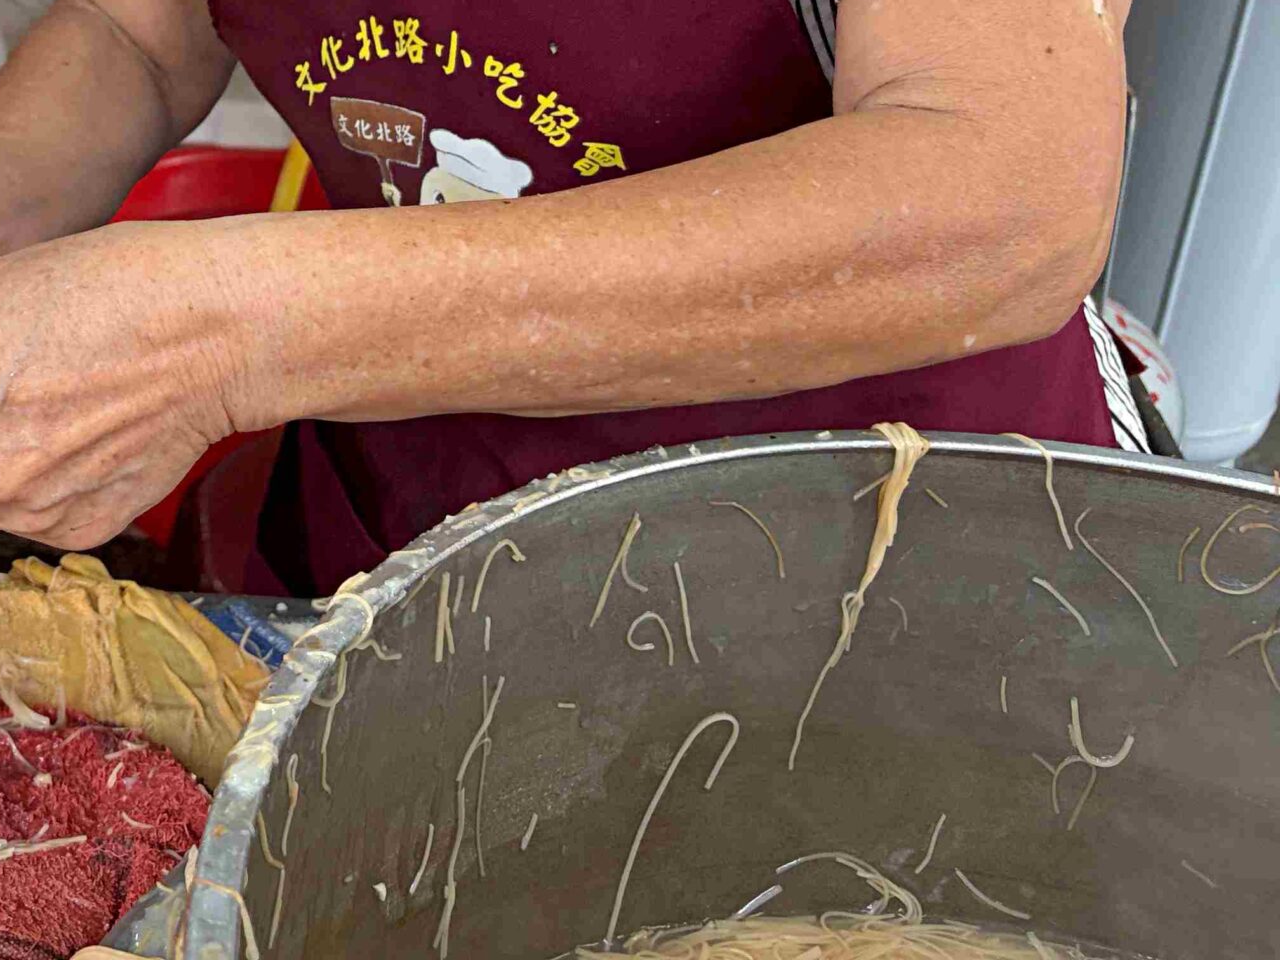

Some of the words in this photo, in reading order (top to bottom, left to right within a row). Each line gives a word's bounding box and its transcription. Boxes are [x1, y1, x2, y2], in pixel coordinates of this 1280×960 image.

[294, 15, 627, 177] 文化北路小吃協會
[337, 112, 416, 147] 文化北路
